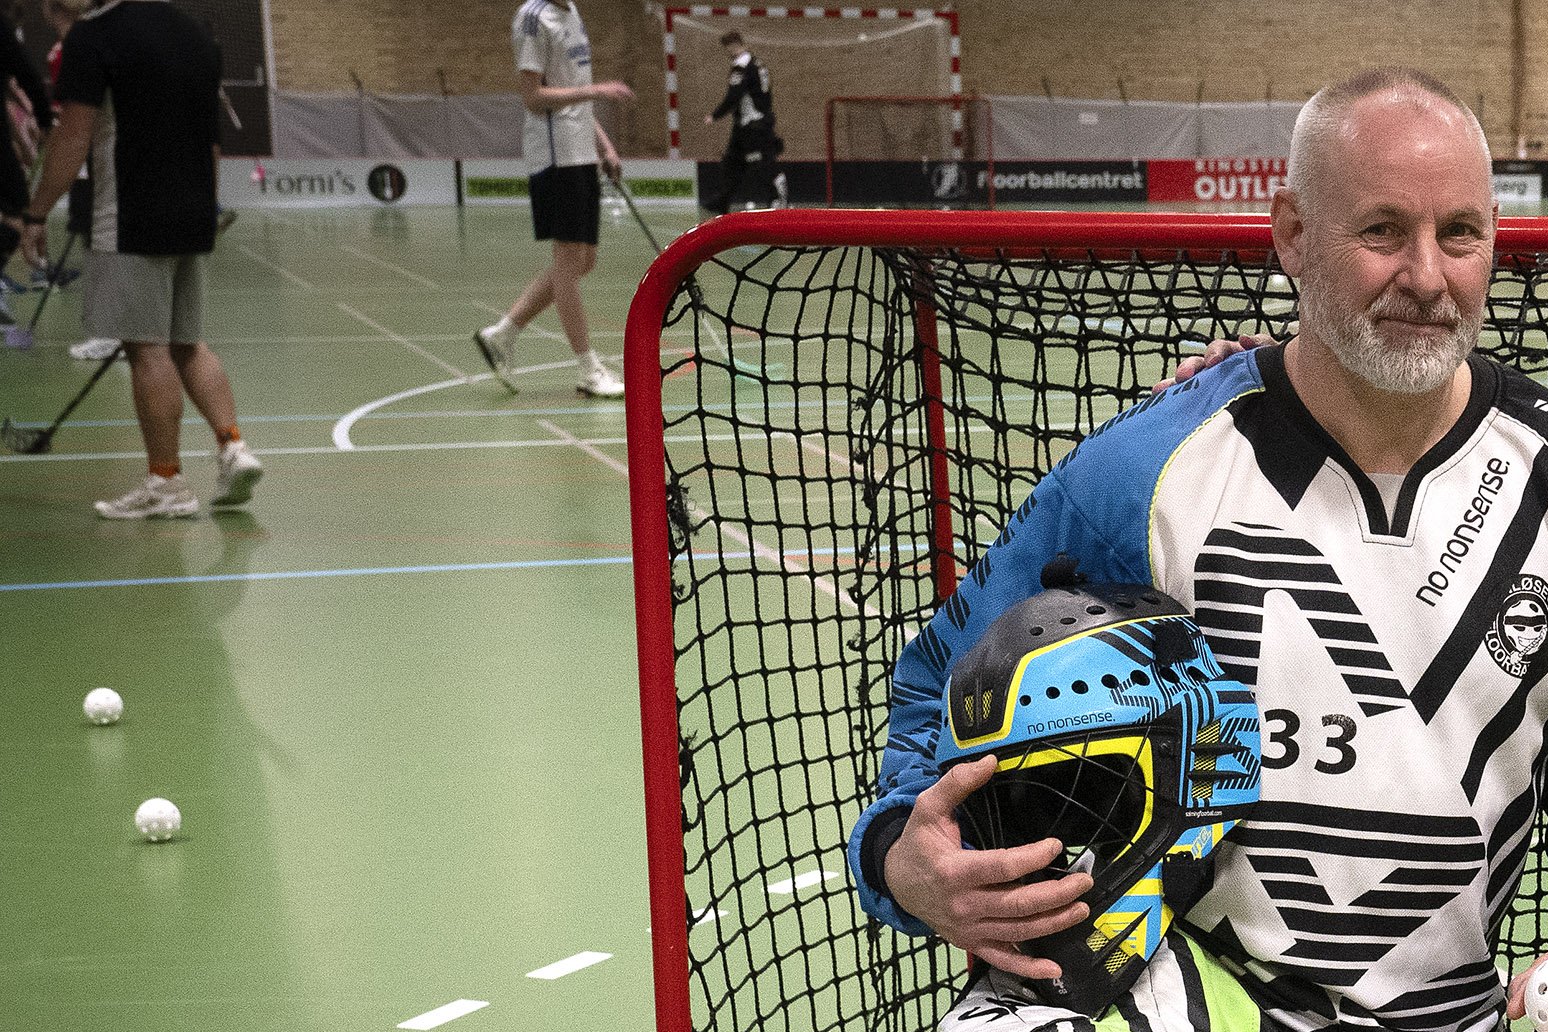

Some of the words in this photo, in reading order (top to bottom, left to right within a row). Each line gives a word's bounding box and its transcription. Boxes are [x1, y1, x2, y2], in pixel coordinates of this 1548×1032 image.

[977, 170, 1144, 190] Foorballcentret
[1194, 175, 1288, 200] OUTLE
[1415, 570, 1450, 608] no
[1027, 721, 1045, 735] no
[1047, 711, 1116, 729] nonsense.
[1261, 708, 1358, 775] 33
